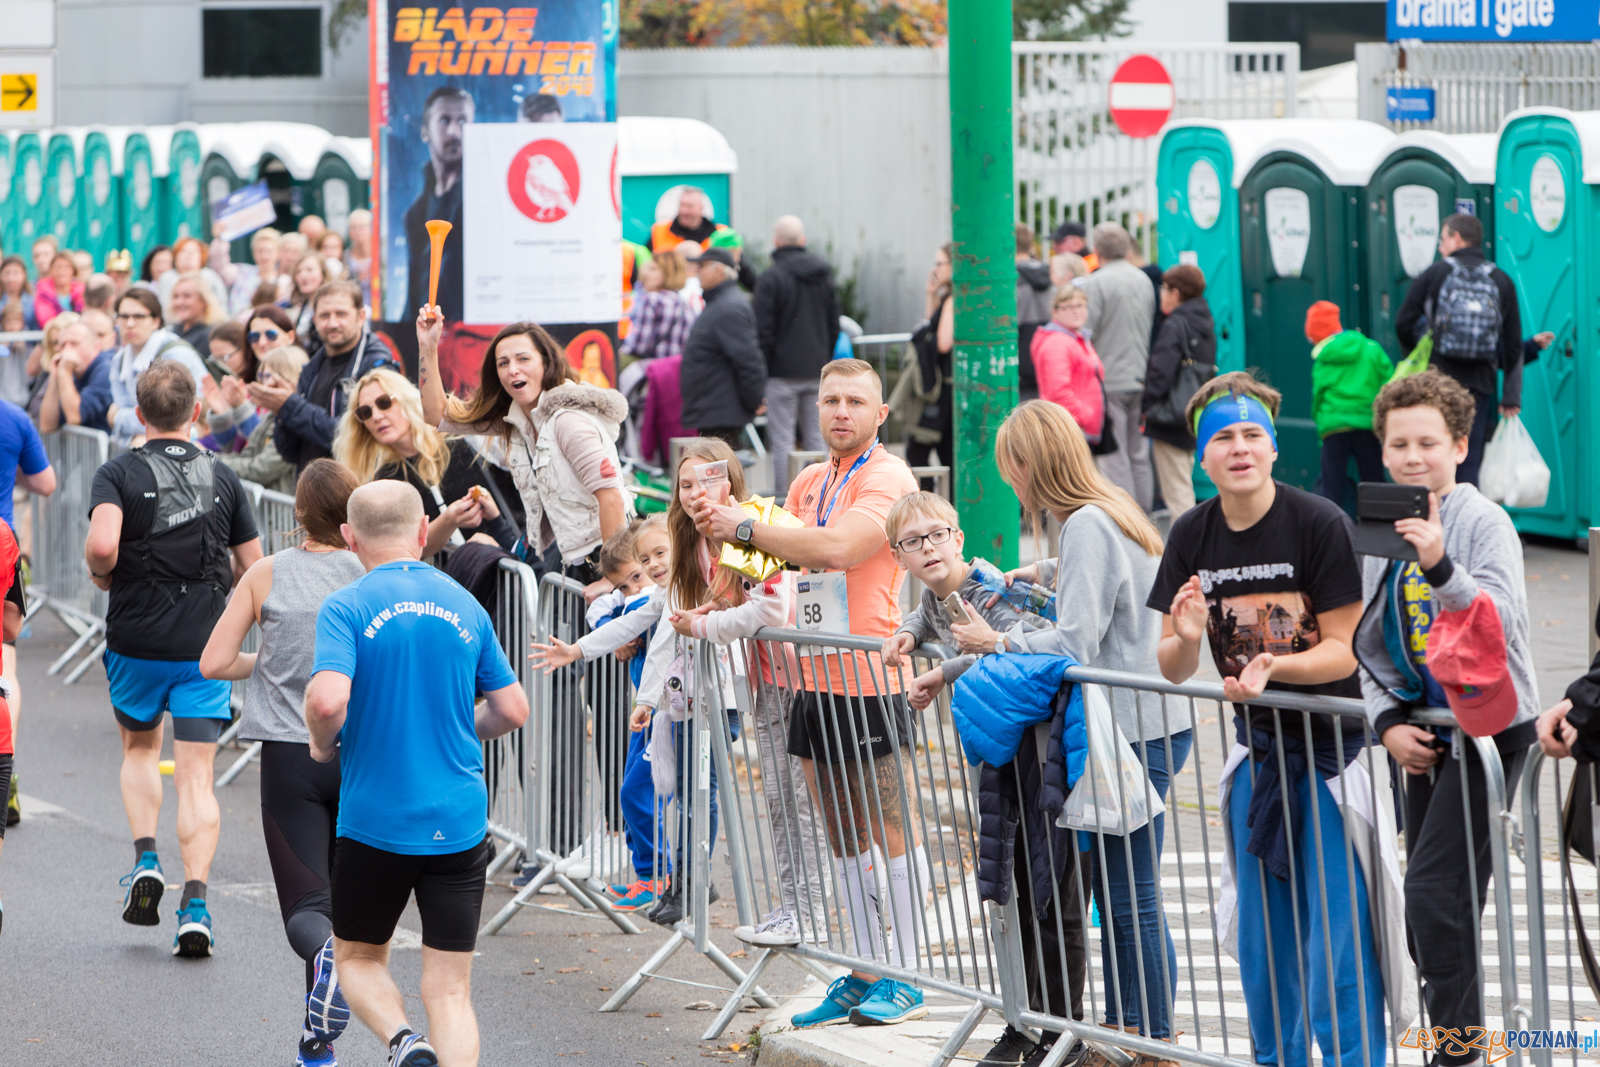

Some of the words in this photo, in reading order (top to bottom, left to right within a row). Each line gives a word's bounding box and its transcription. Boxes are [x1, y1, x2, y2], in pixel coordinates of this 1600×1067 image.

[393, 7, 539, 42] BLADE
[1395, 0, 1477, 28] brama
[1495, 0, 1556, 38] gate
[407, 40, 597, 76] RUNNER
[363, 601, 474, 644] www.czaplinek.pl
[804, 603, 822, 624] 58
